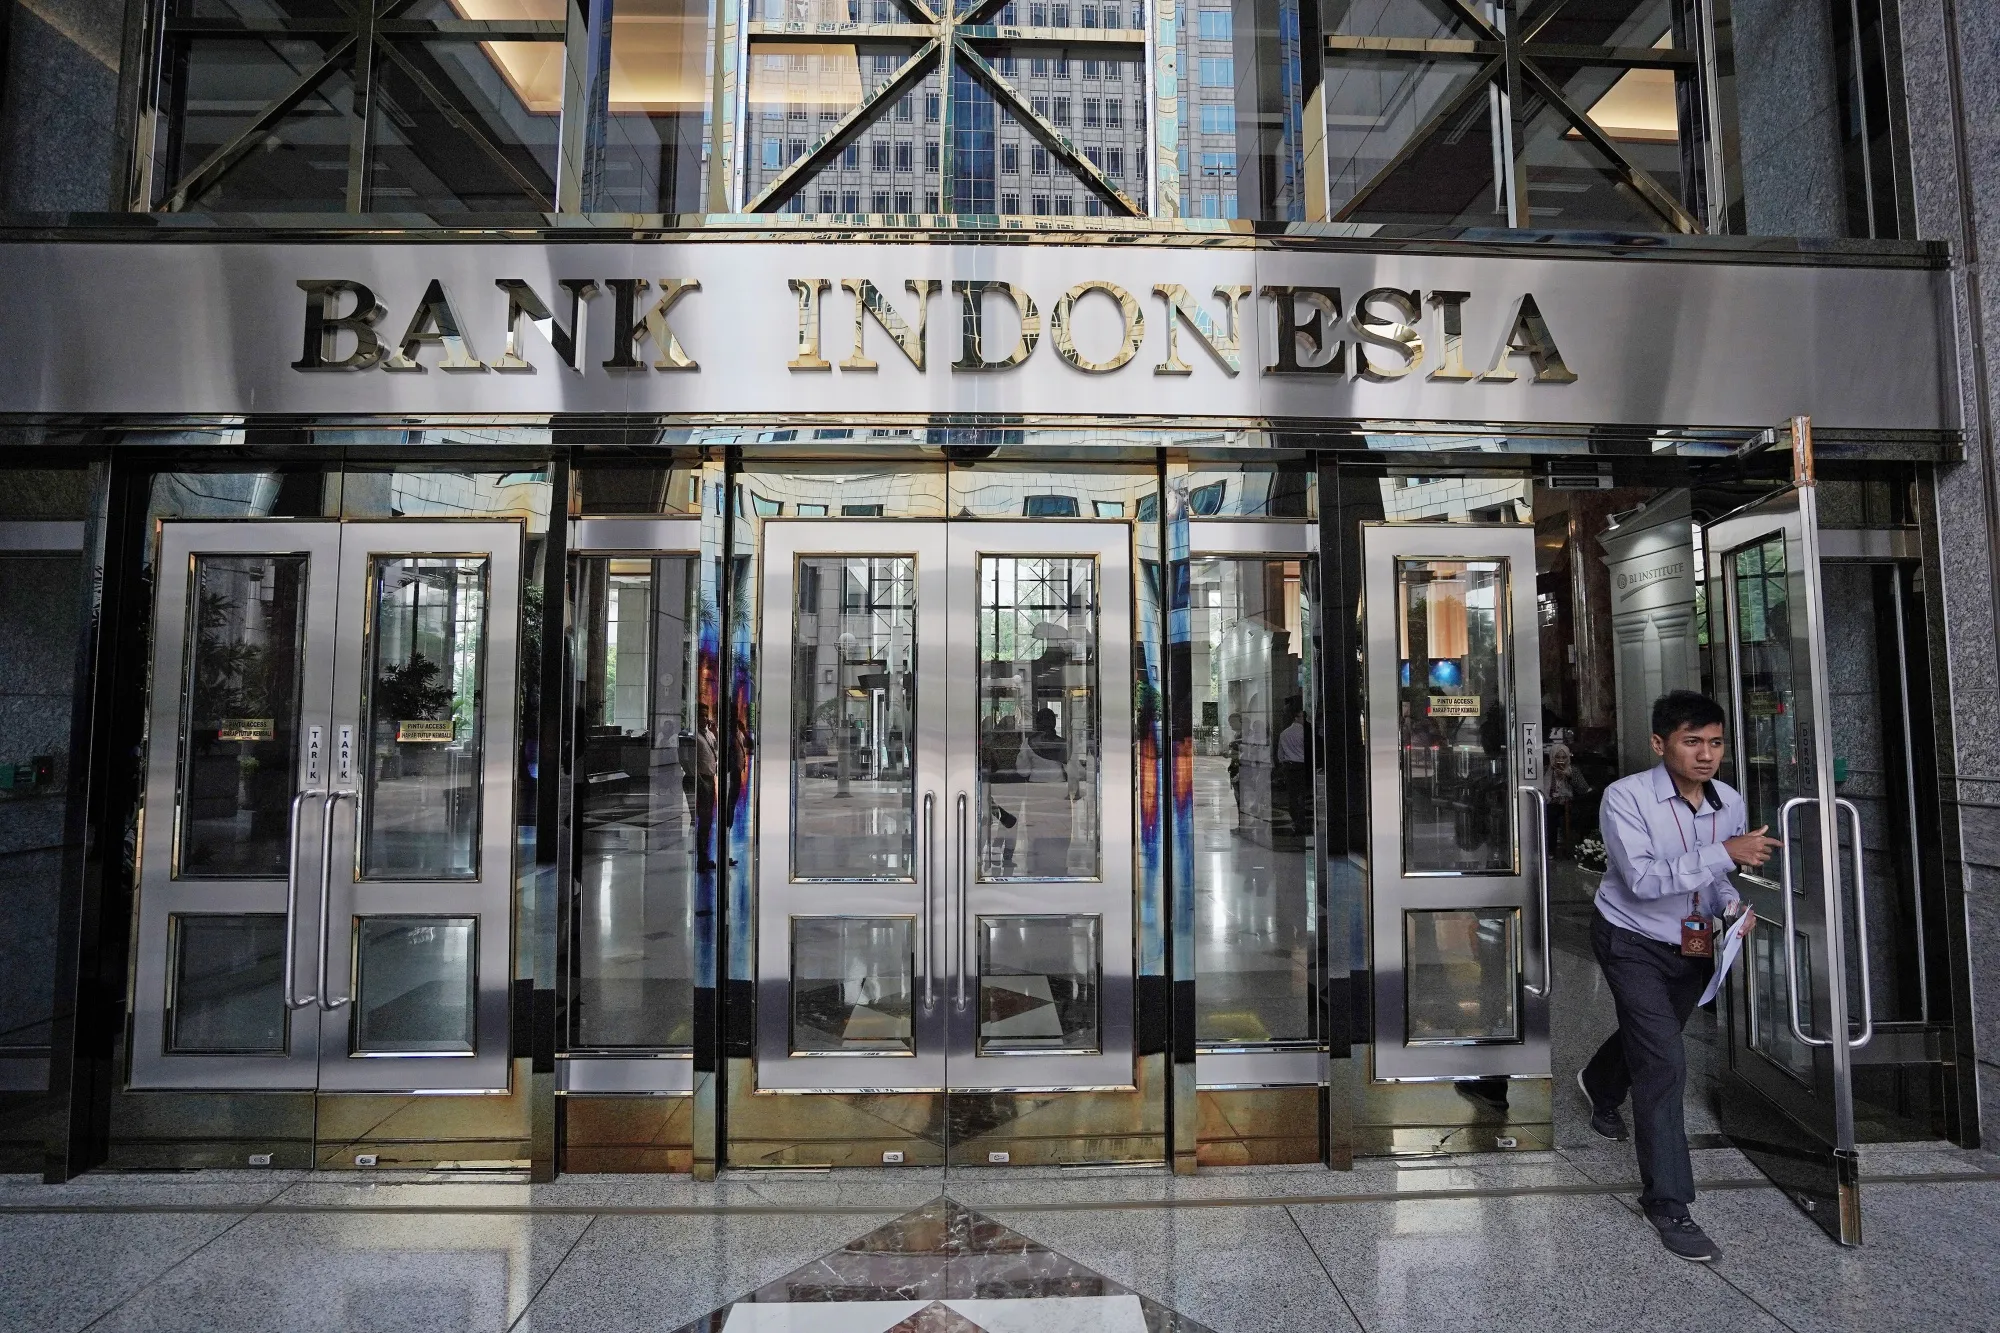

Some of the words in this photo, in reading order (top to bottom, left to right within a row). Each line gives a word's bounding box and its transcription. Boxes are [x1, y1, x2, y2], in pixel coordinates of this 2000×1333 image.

[291, 278, 702, 373] BANK
[786, 278, 1578, 385] INDONESIA
[1629, 573, 1637, 585] BI
[1639, 562, 1684, 582] INSTITUTE
[310, 731, 319, 779] TARIK
[341, 730, 350, 779] TARIK
[1526, 728, 1534, 775] TARIK
[1802, 728, 1812, 785] DORONG
